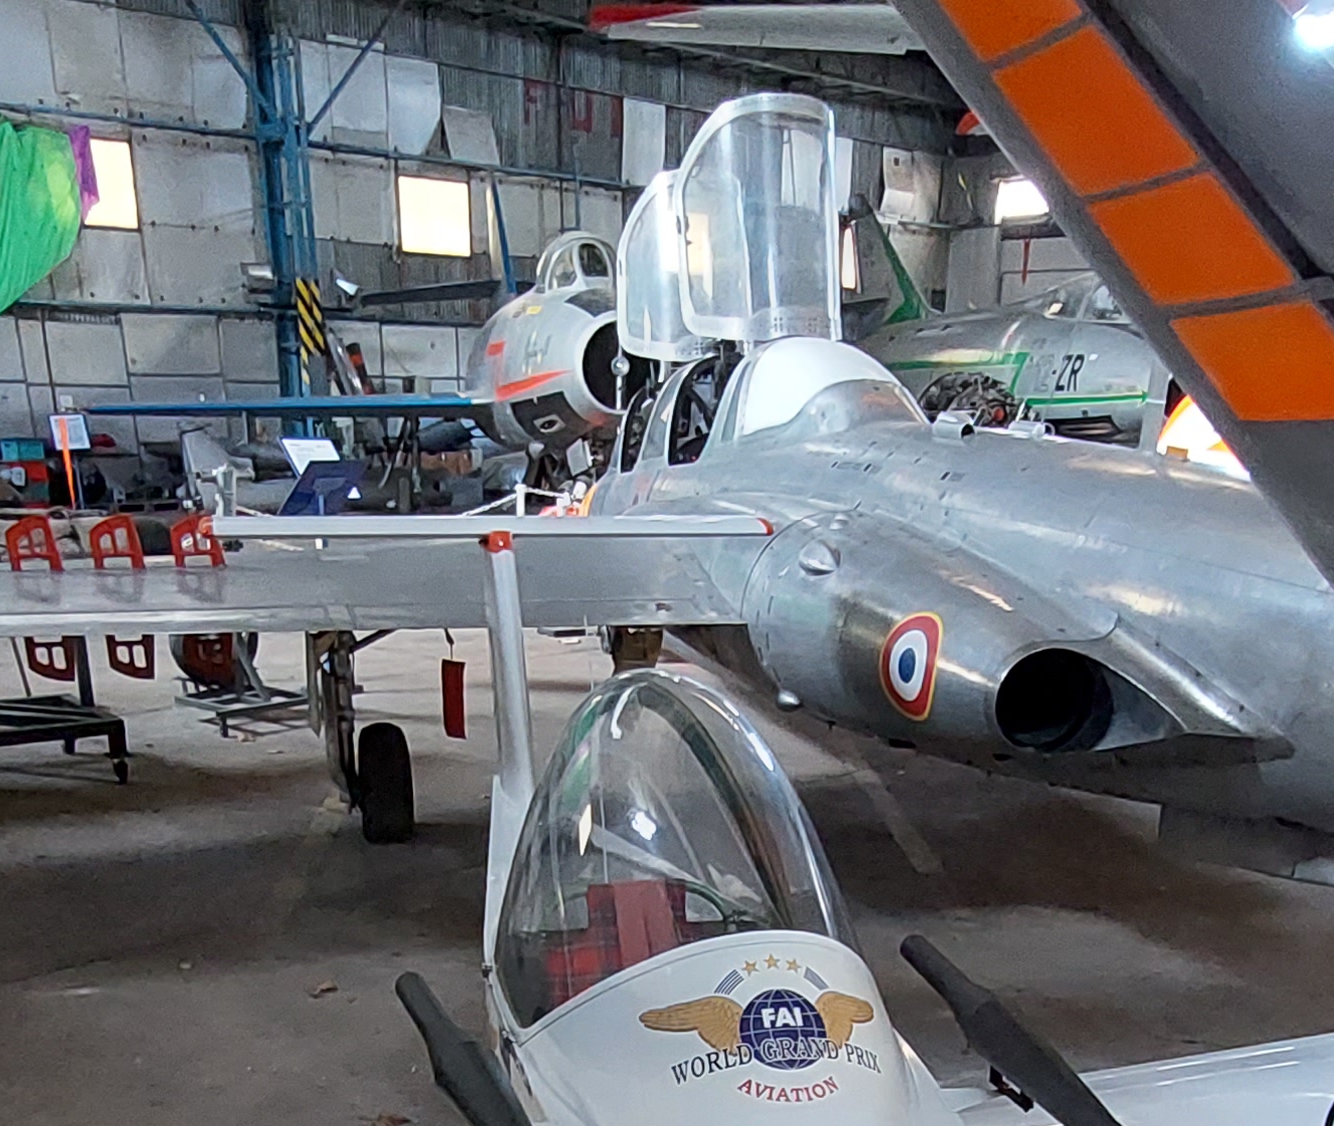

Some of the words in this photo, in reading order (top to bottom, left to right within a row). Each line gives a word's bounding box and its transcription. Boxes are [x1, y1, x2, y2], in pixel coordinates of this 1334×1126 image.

[761, 1006, 804, 1029] FAI
[671, 1044, 754, 1086] WORLD
[761, 1038, 839, 1063] GRAND
[845, 1043, 882, 1074] PRIX
[737, 1075, 840, 1103] AVIATION
